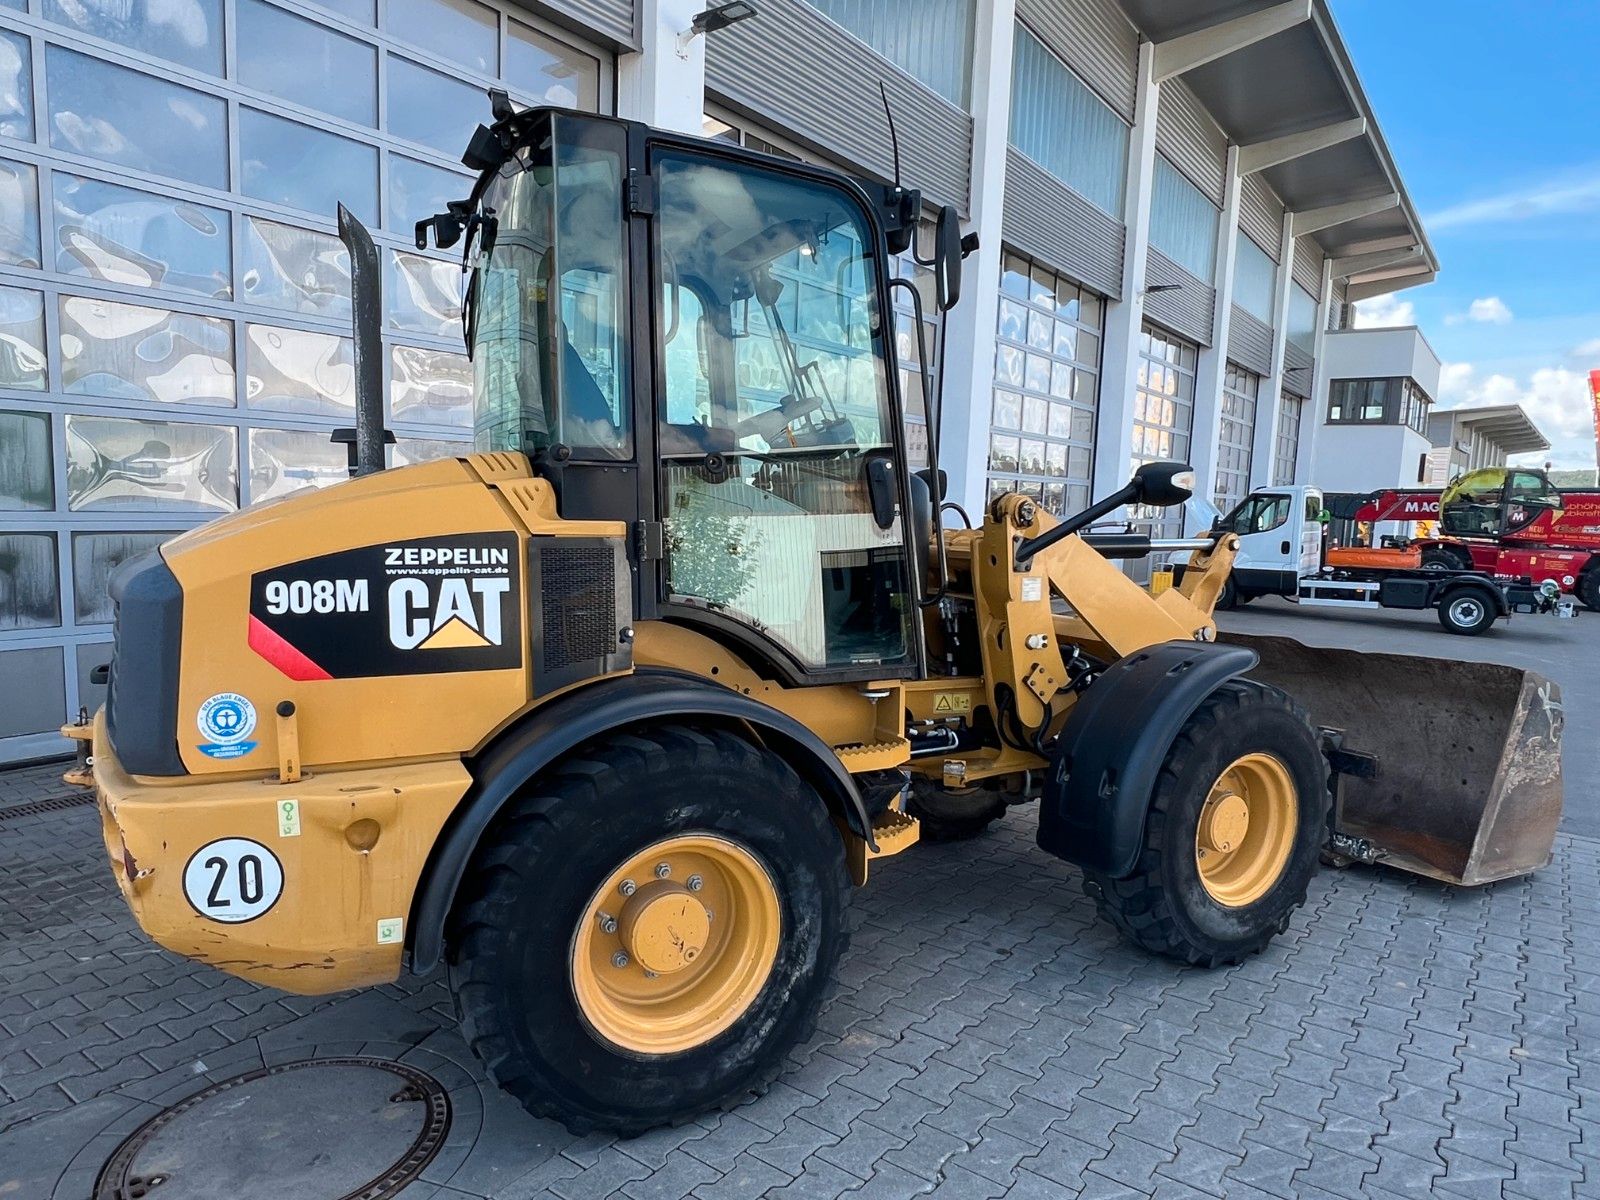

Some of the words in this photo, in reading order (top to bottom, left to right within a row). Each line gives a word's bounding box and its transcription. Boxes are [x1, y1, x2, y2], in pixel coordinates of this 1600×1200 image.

[1512, 512, 1524, 521] M
[385, 548, 509, 565] ZEPPELIN
[385, 567, 509, 576] www.zeppelin-cat.de
[265, 579, 370, 615] 908M
[388, 577, 511, 650] CAT
[212, 694, 232, 703] BLAUE
[233, 695, 250, 709] ENGEL
[204, 854, 264, 907] 20
